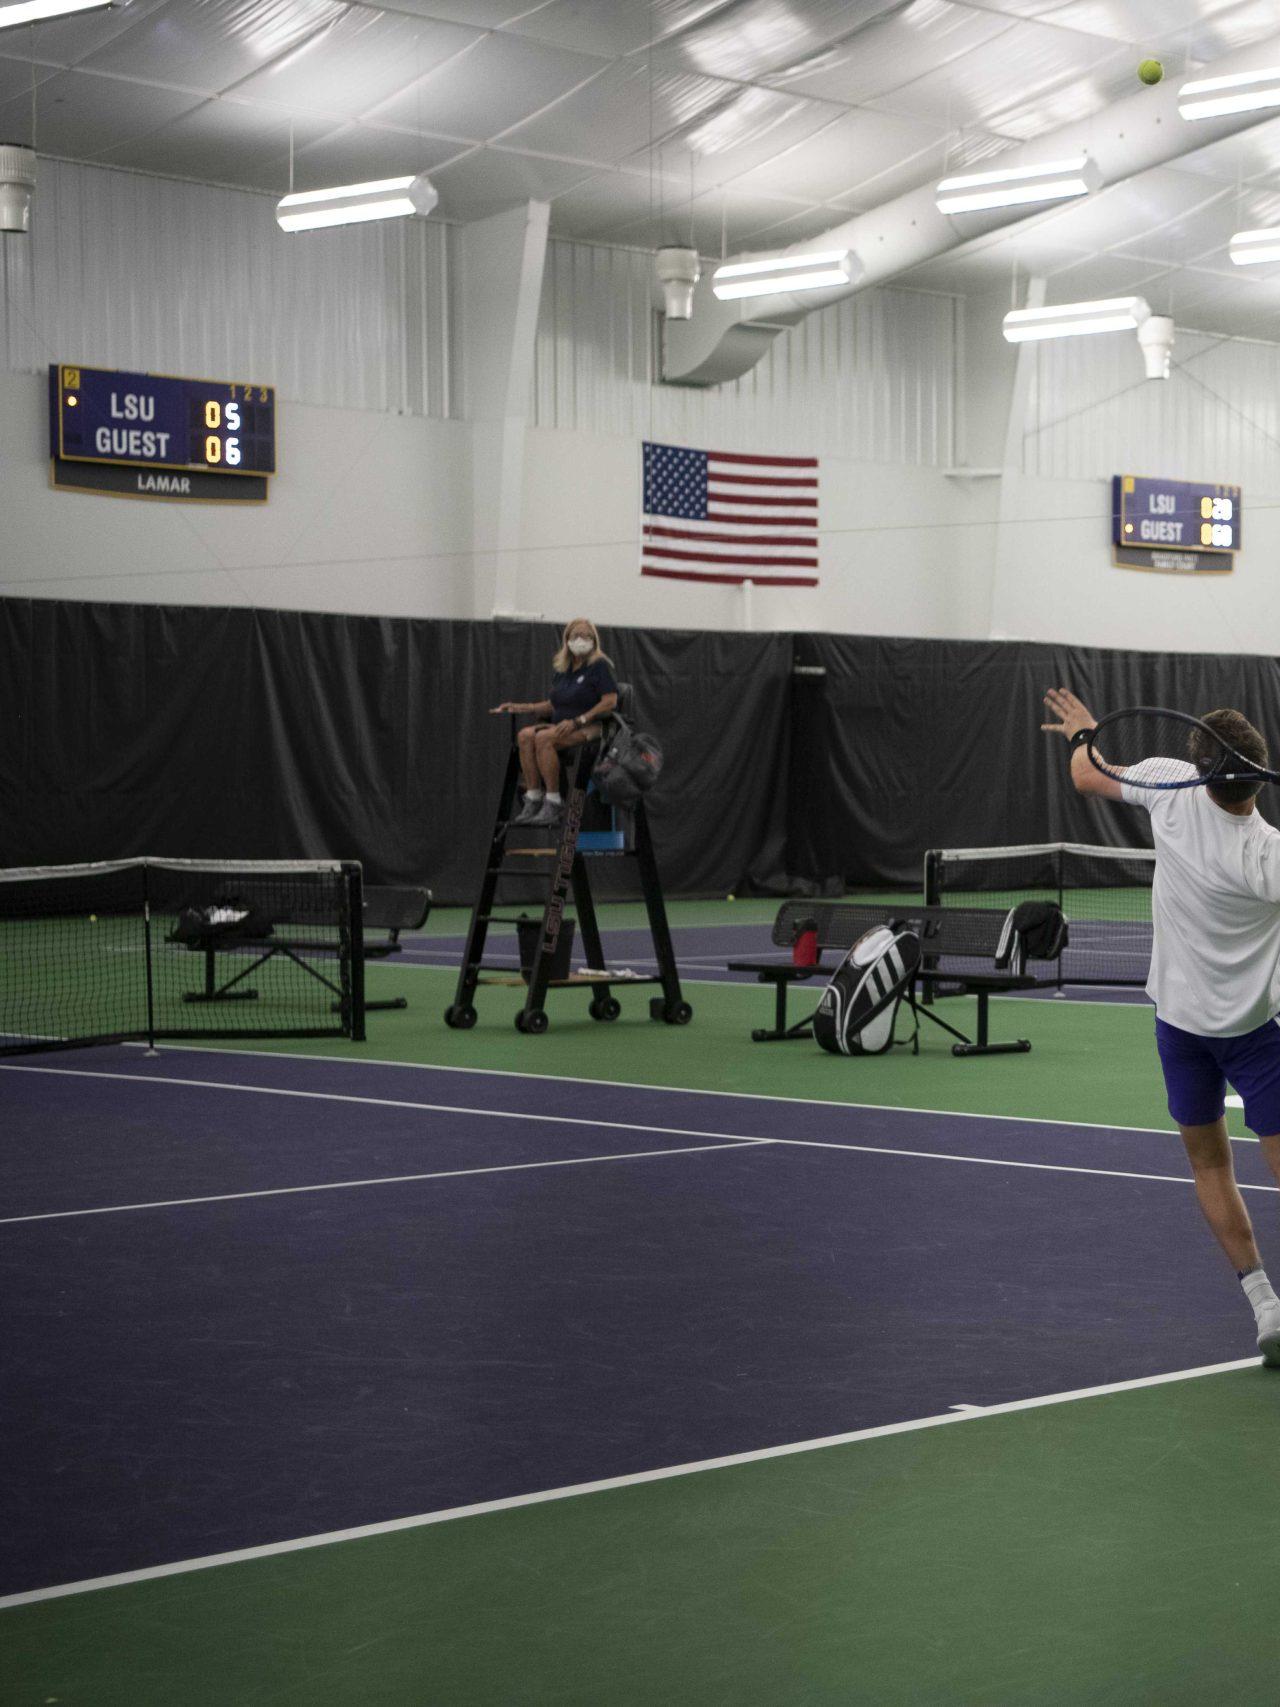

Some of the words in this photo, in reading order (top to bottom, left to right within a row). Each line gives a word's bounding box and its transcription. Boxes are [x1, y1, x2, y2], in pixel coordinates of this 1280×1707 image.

[110, 393, 155, 421] LSU
[95, 427, 170, 458] GUEST
[137, 474, 190, 494] LAMAR
[1149, 494, 1176, 514] LSU
[1140, 519, 1183, 542] GUEST
